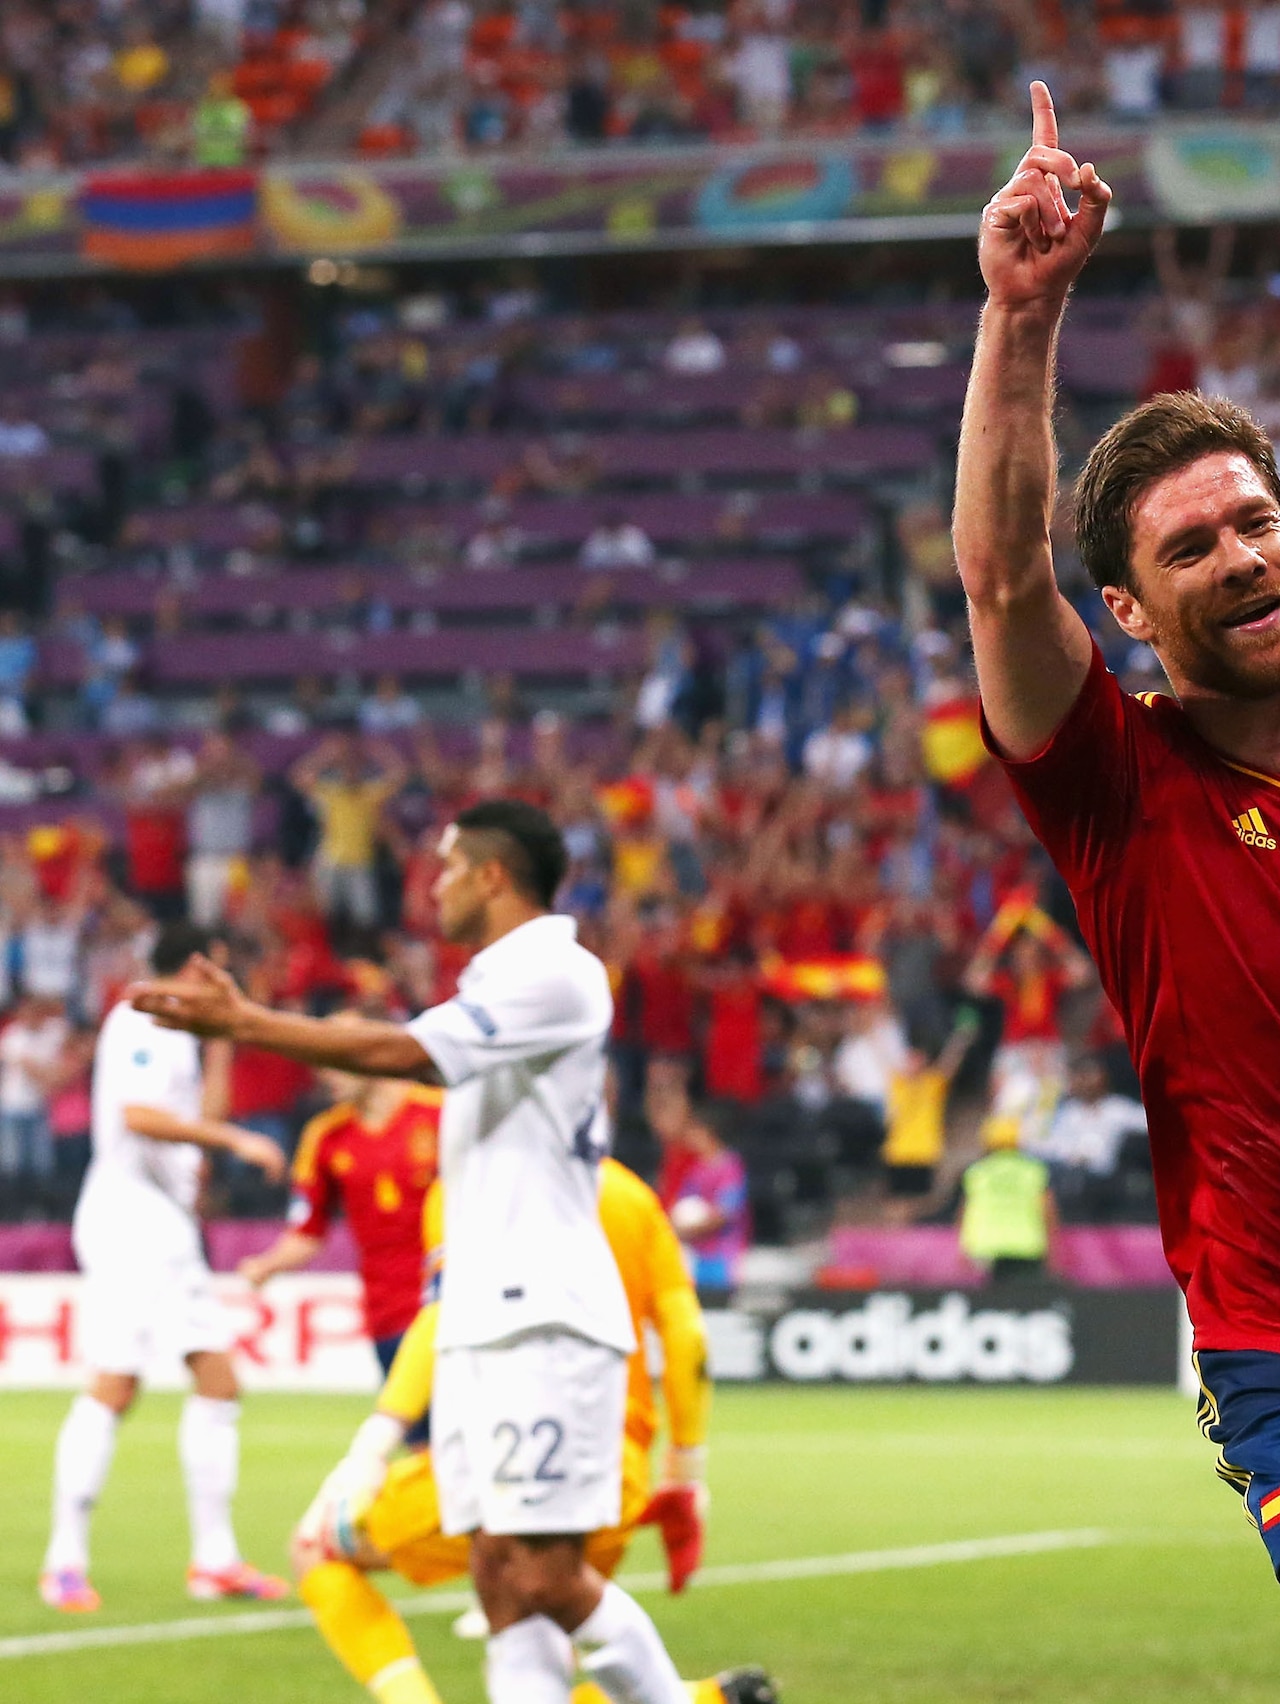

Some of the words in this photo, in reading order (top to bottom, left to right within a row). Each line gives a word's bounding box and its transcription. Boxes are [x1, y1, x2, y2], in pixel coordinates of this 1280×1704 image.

[1236, 828, 1277, 850] idas
[770, 1291, 1076, 1382] adidas
[492, 1417, 566, 1484] 22
